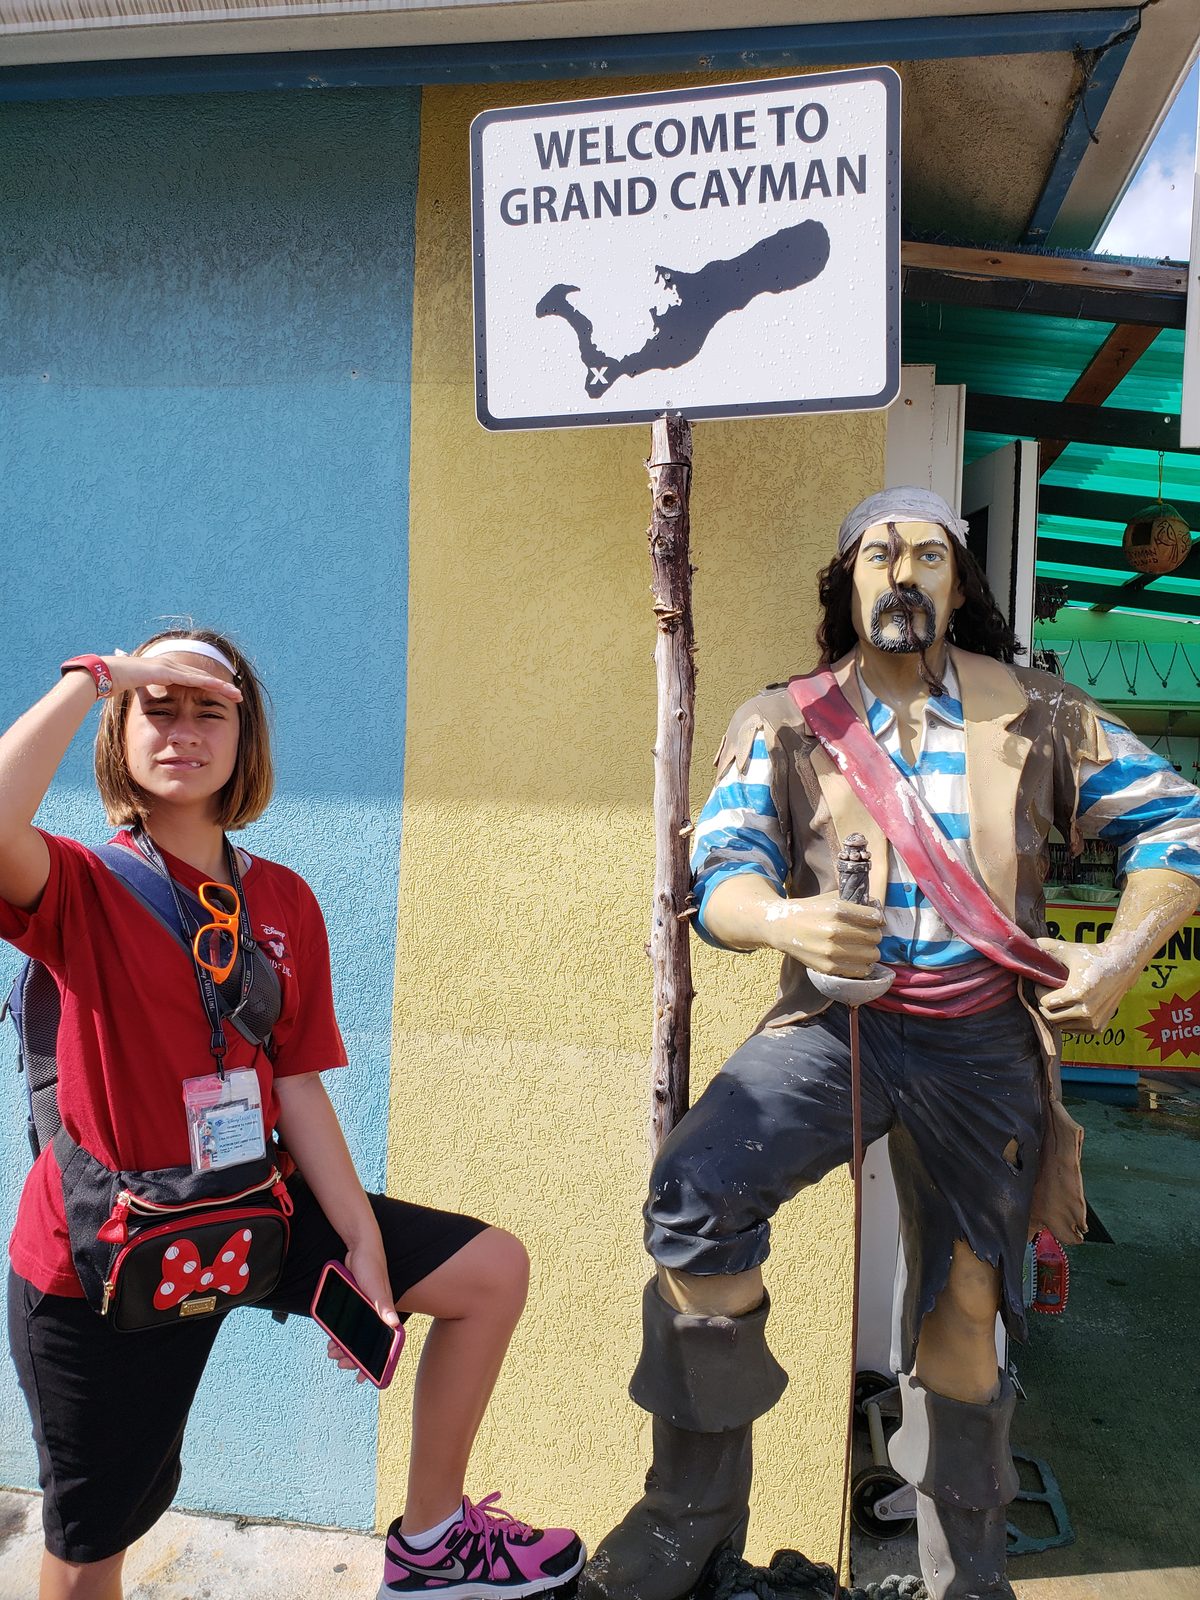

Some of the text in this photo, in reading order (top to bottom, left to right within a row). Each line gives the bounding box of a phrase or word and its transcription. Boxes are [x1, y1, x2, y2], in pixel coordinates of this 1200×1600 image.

[533, 102, 829, 170] WELCOME TO
[500, 154, 868, 226] GRAND CAYMAN
[1171, 1007, 1194, 1024] US
